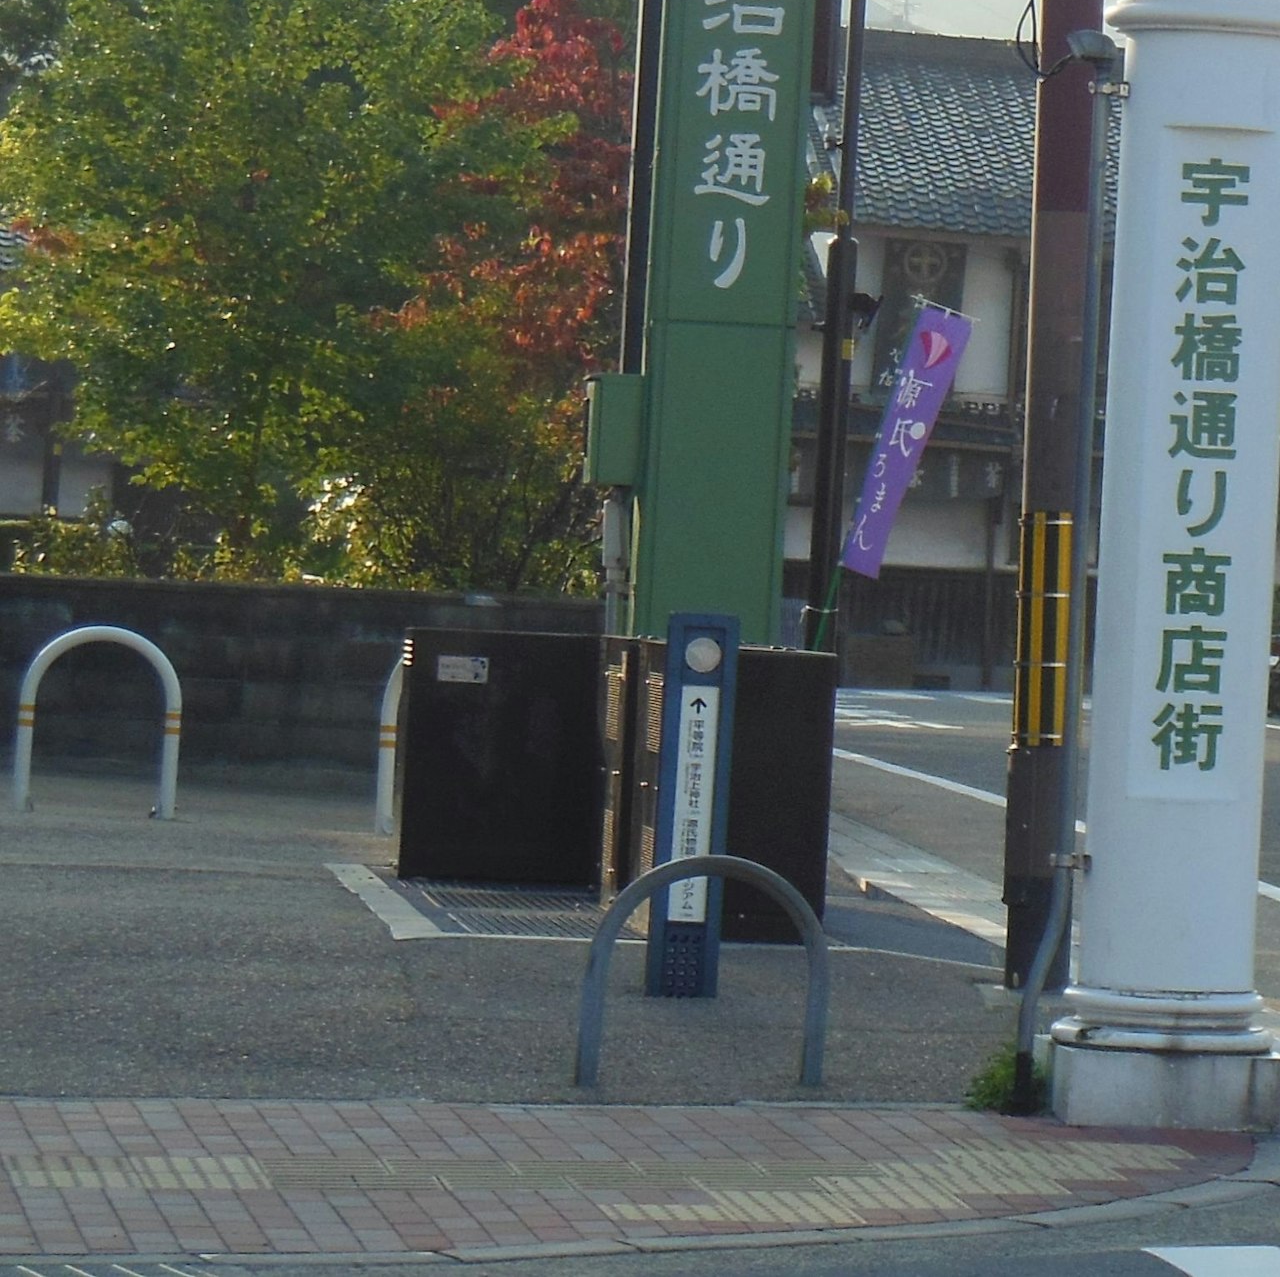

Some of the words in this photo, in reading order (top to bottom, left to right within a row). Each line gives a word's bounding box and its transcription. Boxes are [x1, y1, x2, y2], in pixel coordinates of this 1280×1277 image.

[1150, 157, 1252, 774] 宇治橋通り商店街
